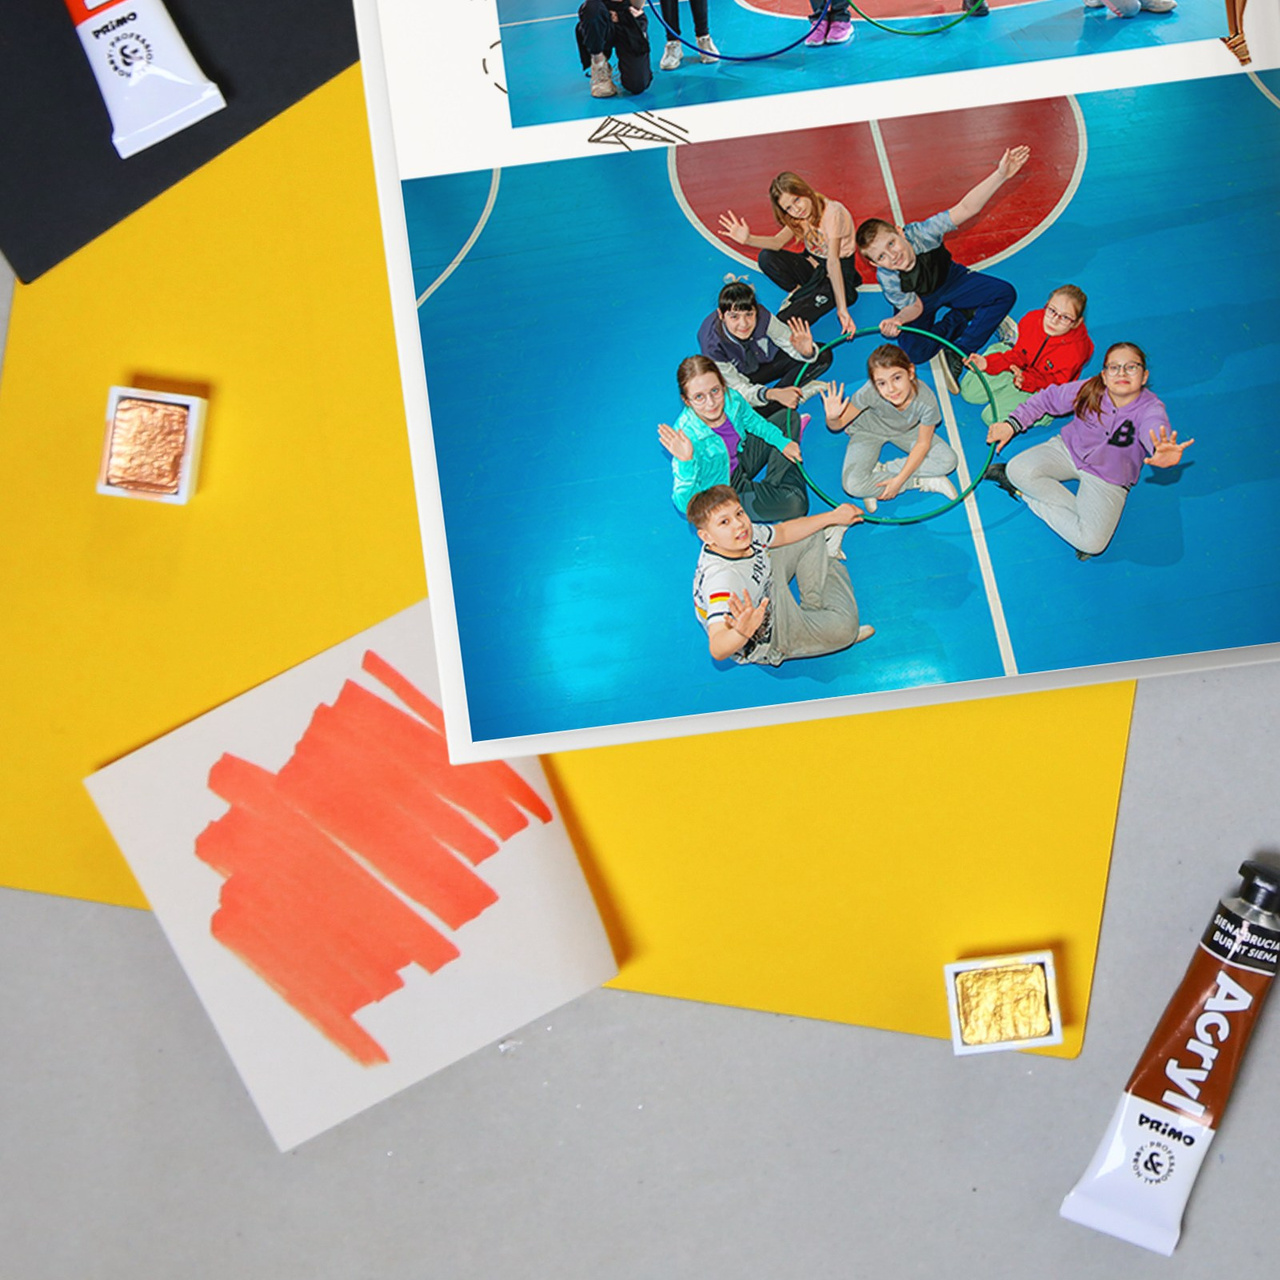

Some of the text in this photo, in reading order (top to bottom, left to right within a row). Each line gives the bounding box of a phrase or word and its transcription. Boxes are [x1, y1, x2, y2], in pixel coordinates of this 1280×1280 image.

[1107, 419, 1135, 448] B
[1213, 913, 1242, 939] SIENA
[1212, 930, 1279, 964] BURNT SIENA
[1161, 968, 1255, 1118] Acryl
